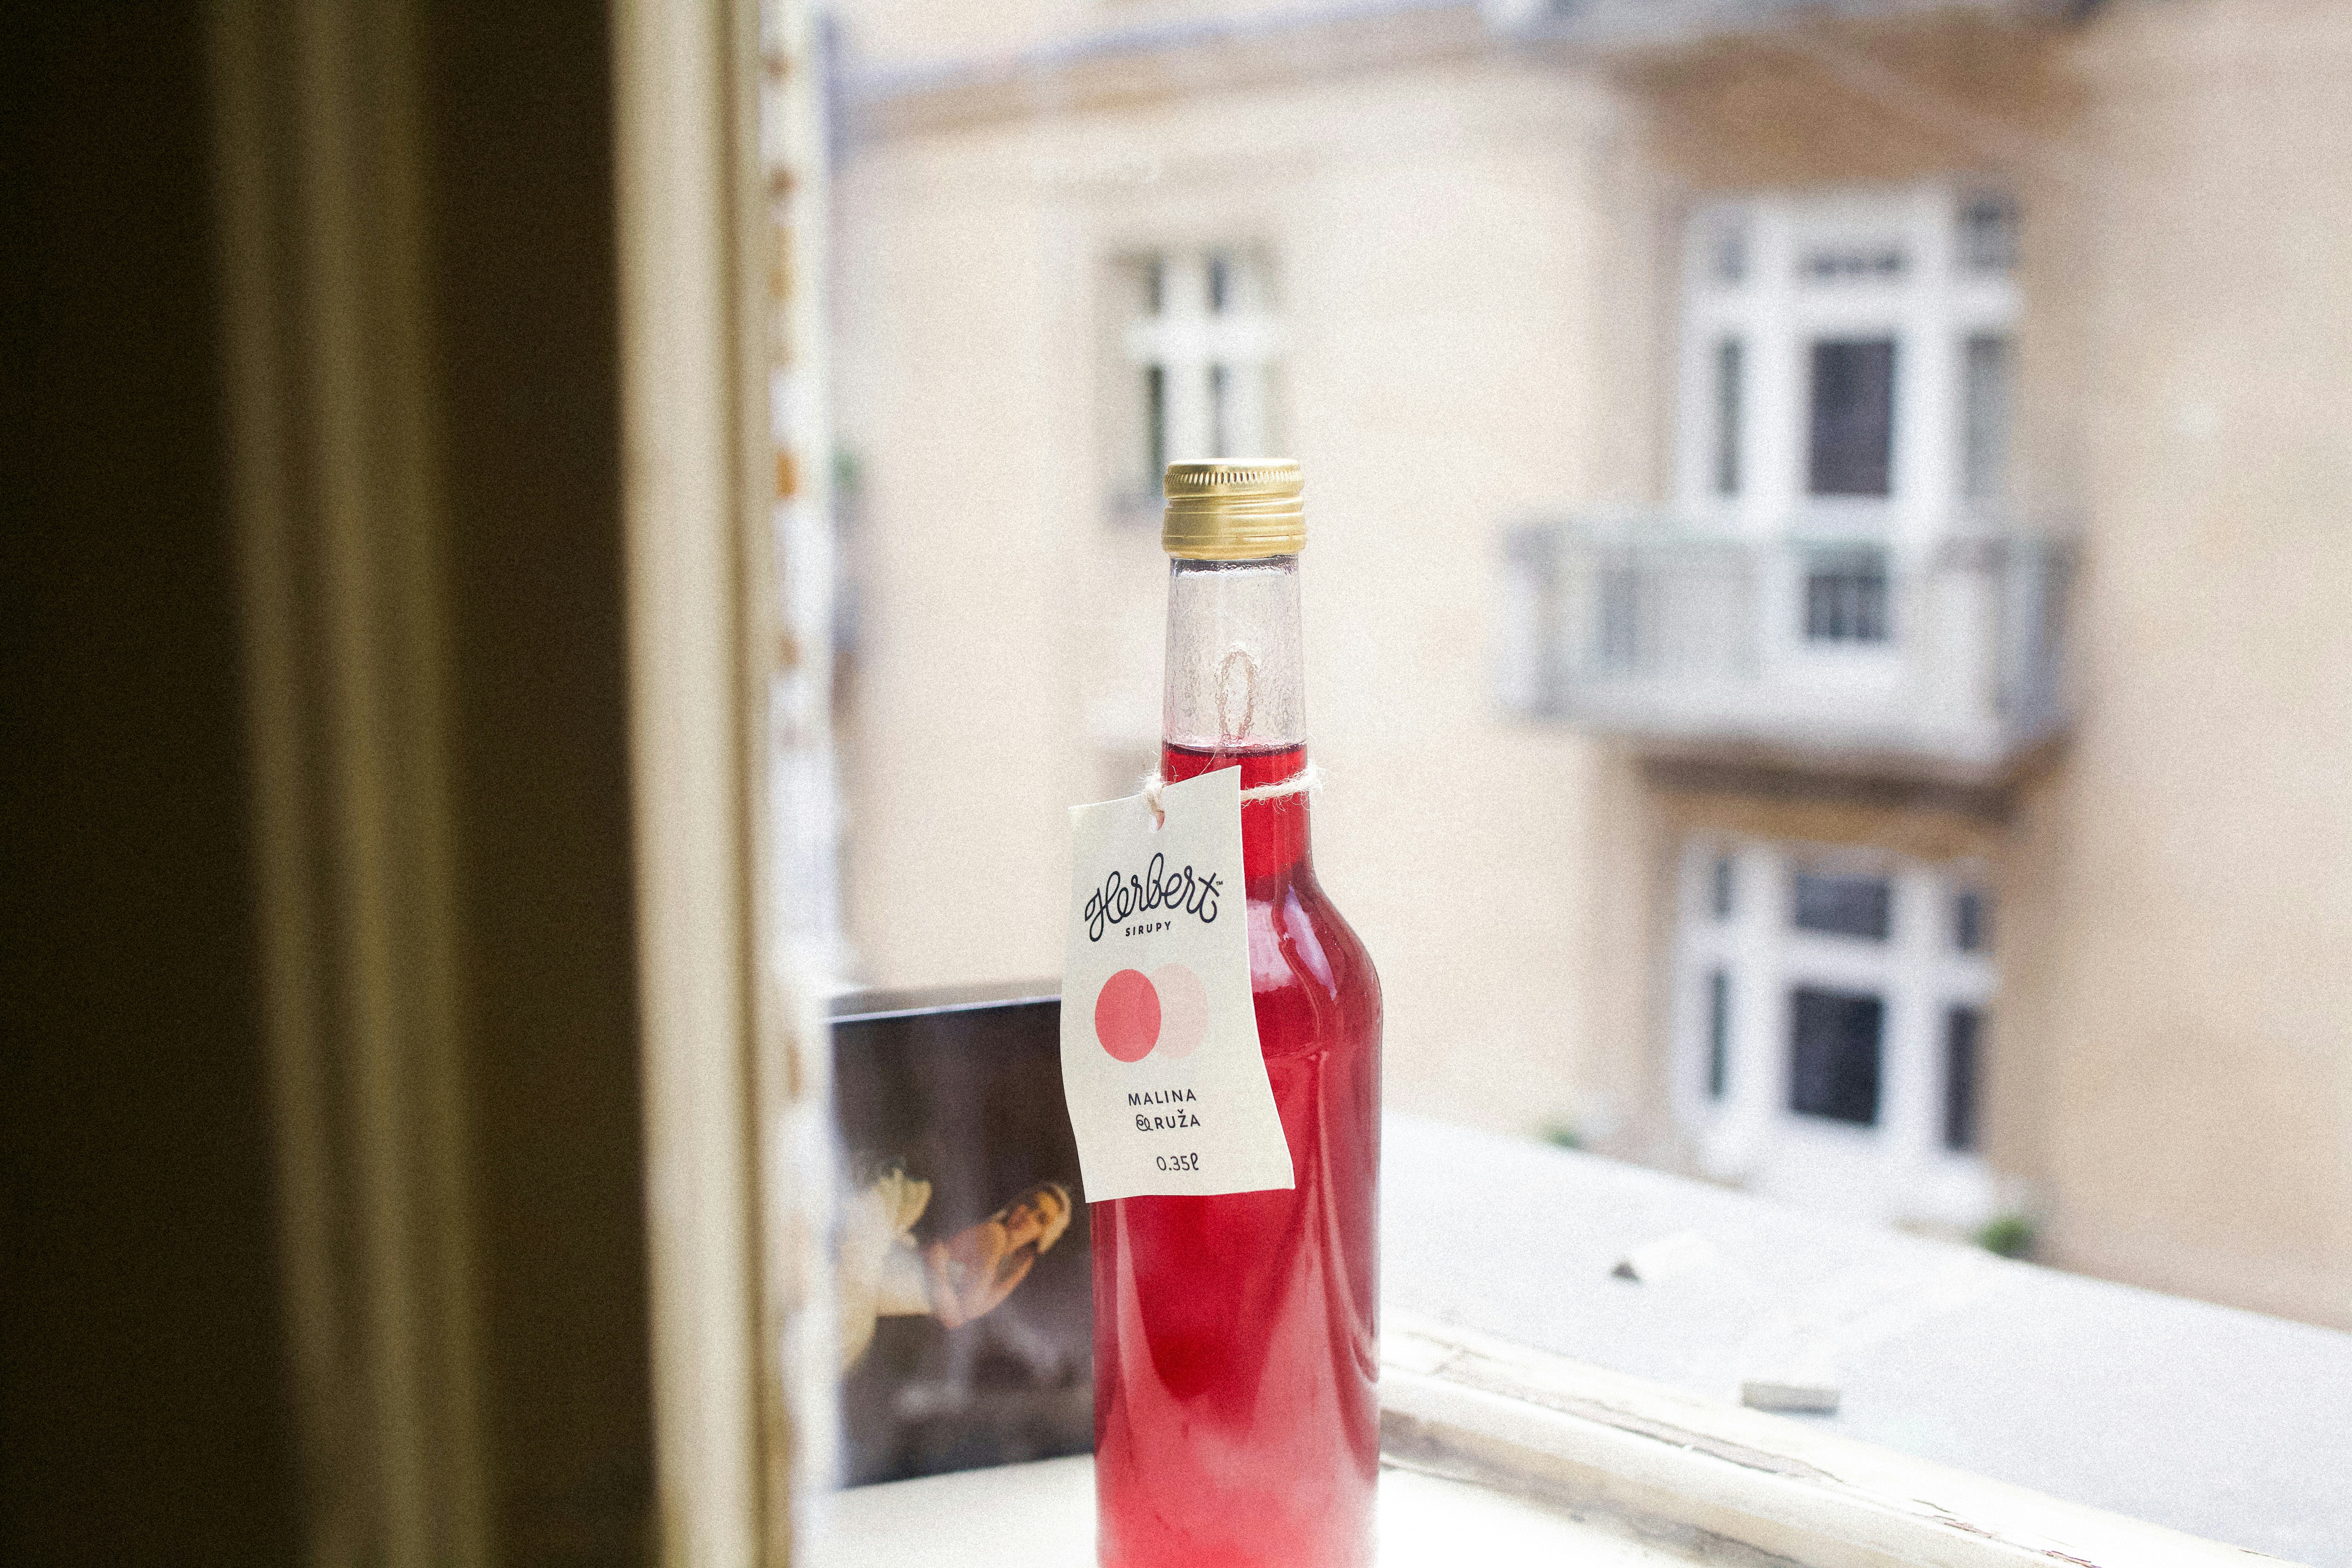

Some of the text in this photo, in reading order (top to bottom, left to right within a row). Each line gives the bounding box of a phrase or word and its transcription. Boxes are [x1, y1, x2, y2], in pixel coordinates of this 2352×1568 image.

[1084, 852, 1220, 942] Herbert
[1125, 921, 1171, 937] SIRUPY
[1128, 1088, 1197, 1106] MALINA
